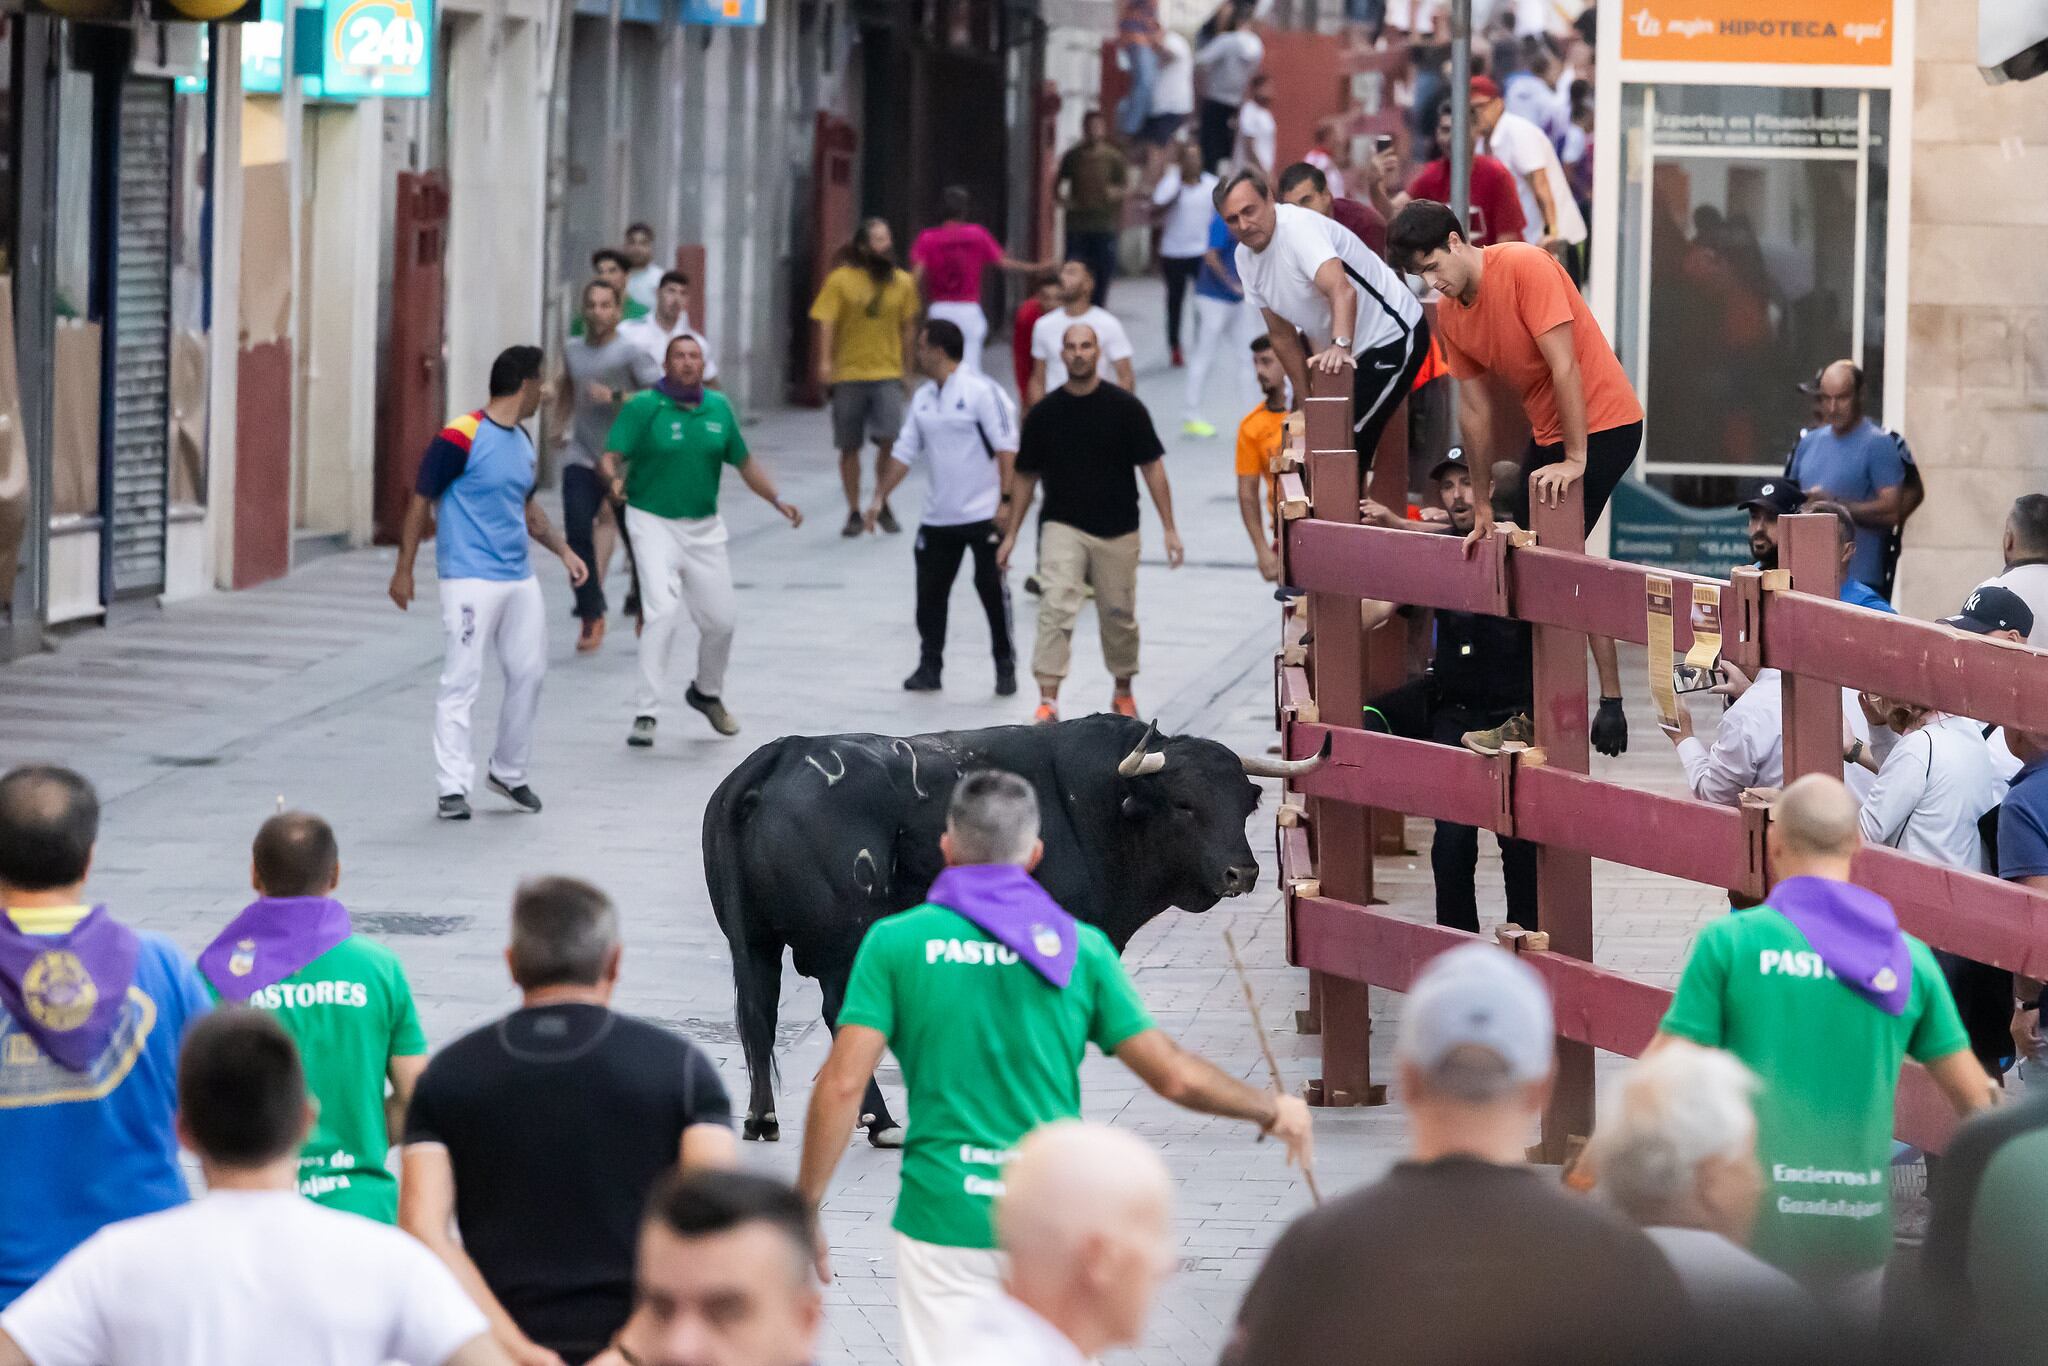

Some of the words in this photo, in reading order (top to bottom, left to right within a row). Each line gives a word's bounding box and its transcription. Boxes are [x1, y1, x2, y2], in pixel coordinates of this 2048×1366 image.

[1719, 19, 1838, 38] HIPOTECA
[925, 938, 1019, 965] PASTO
[1759, 949, 1830, 980] PAST
[250, 980, 368, 1009] ASTORES
[330, 1149, 355, 1169] de
[1773, 1163, 1868, 1186] Encierros
